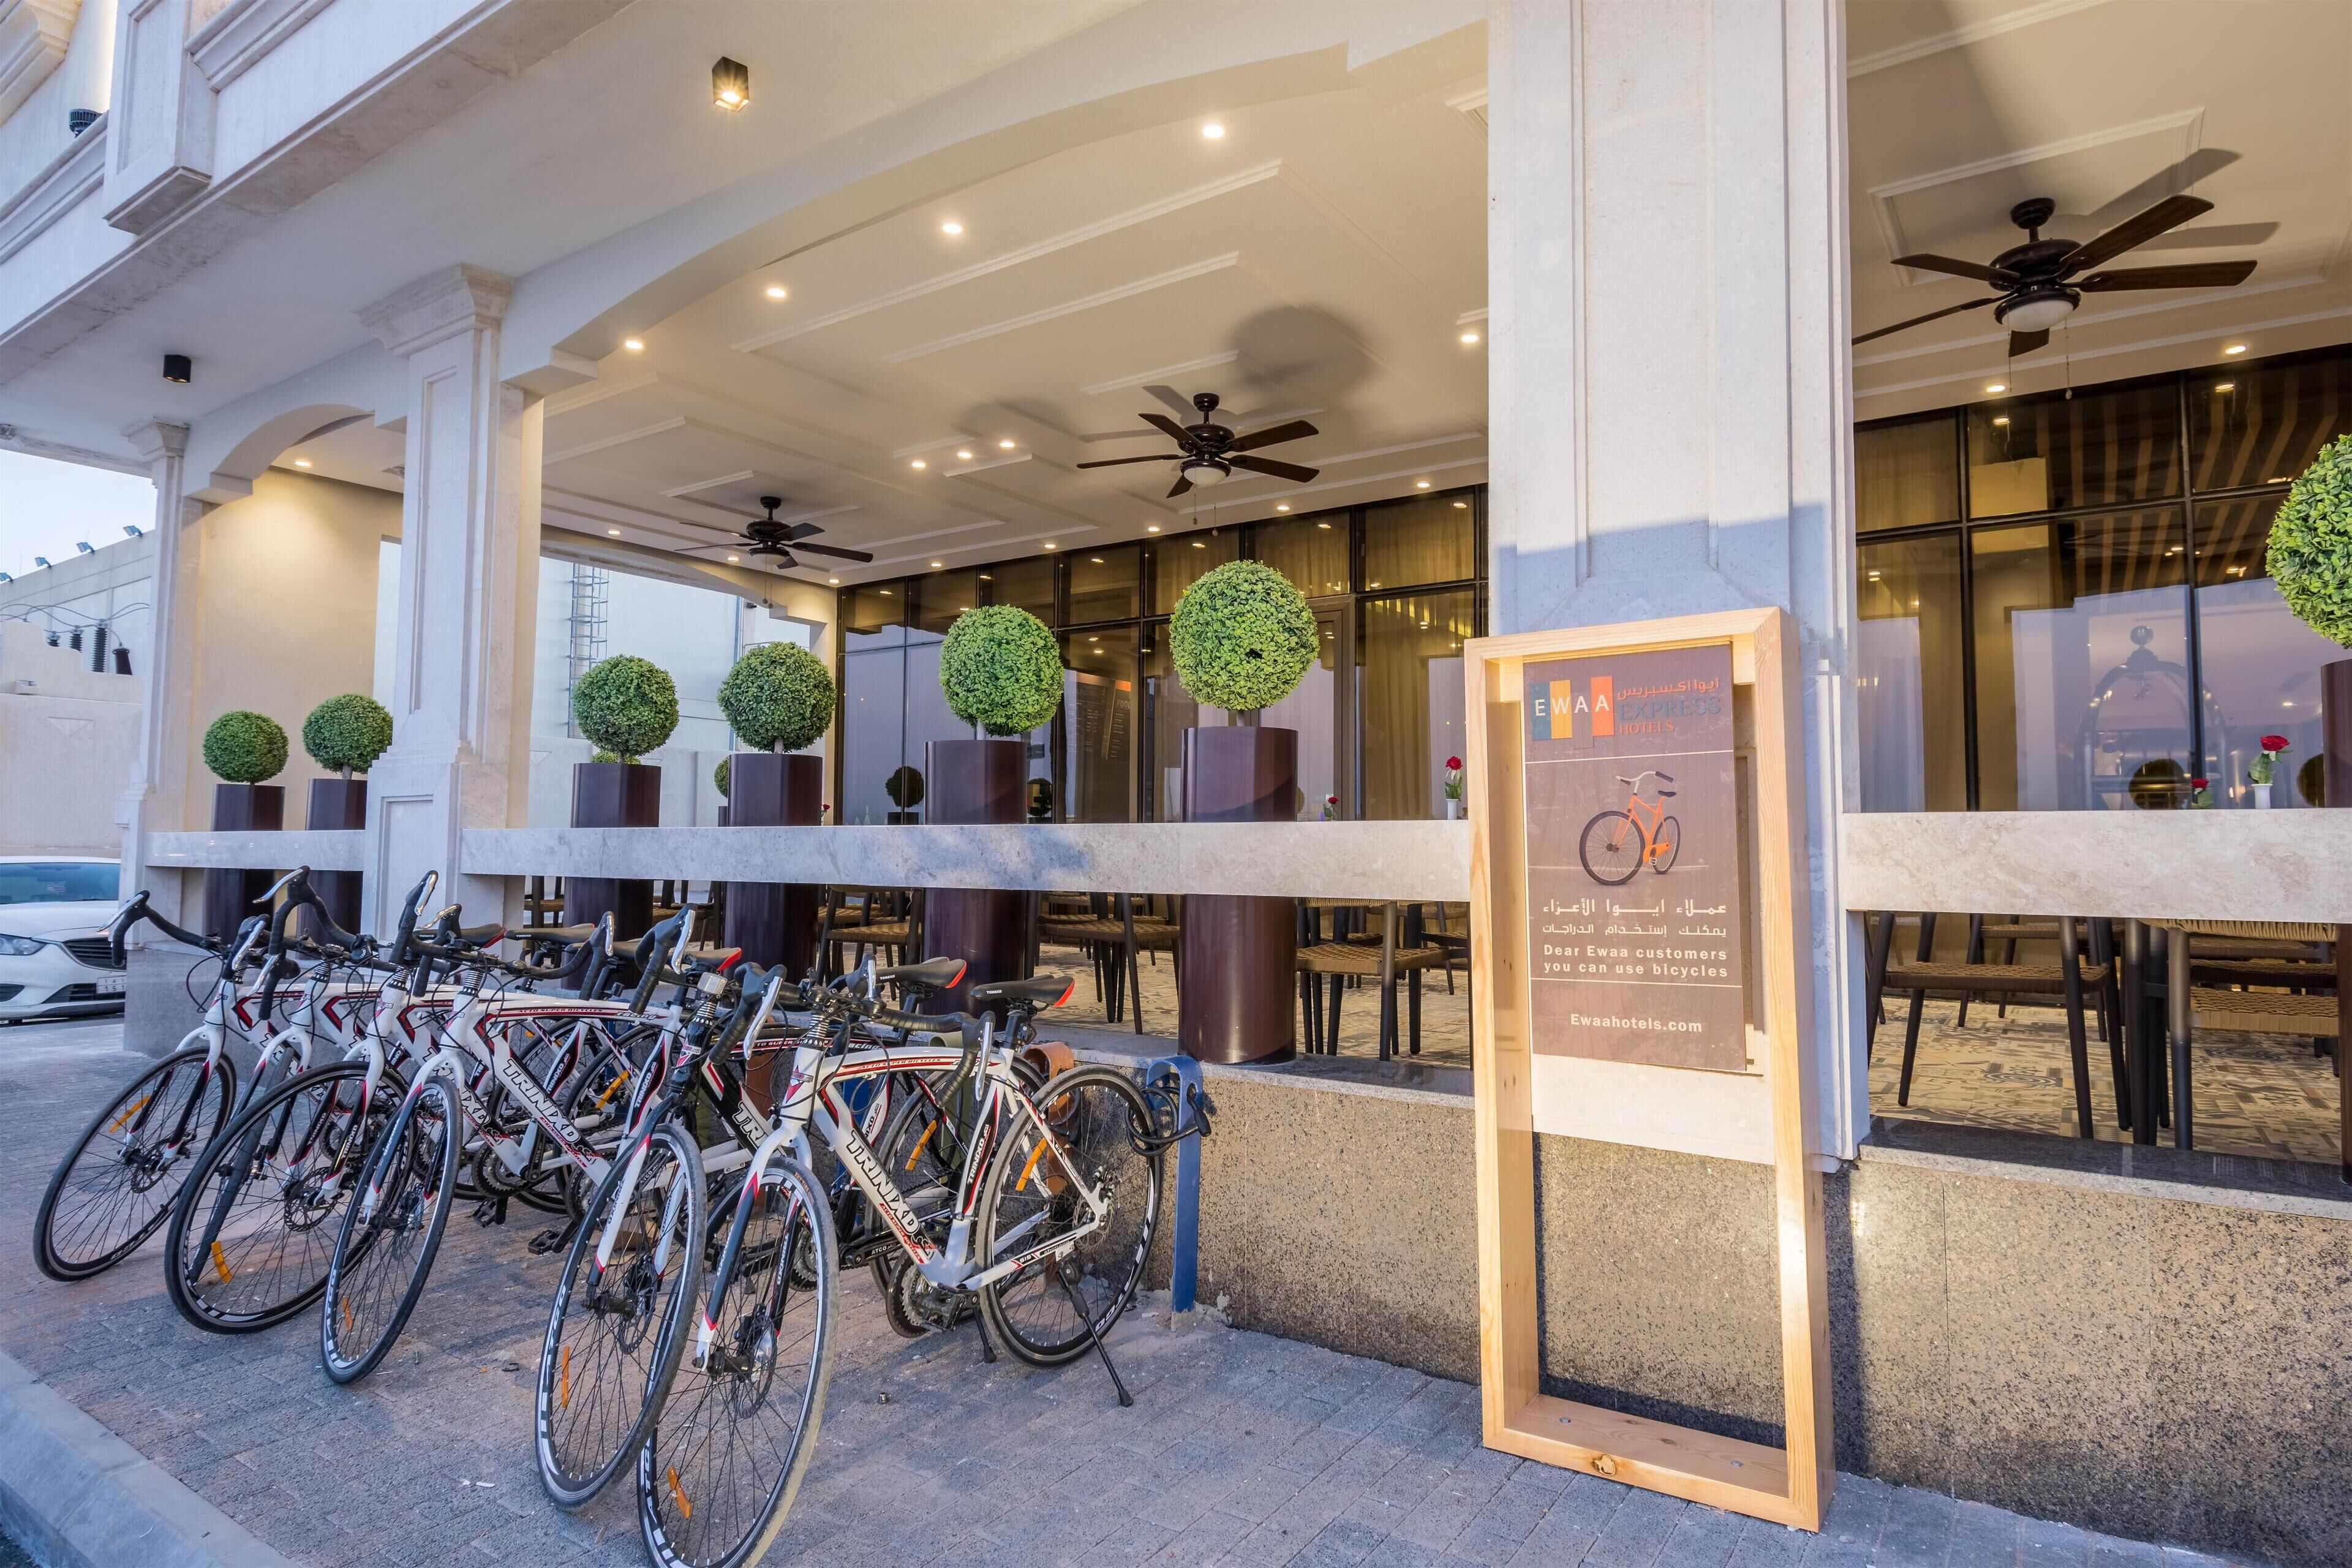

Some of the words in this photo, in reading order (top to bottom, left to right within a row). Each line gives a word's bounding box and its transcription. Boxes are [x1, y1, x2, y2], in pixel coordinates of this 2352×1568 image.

[1616, 679, 1692, 700] اكسبريس
[1694, 676, 1720, 693] ايوا
[1534, 694, 1610, 717] EWAA
[1619, 695, 1721, 722] EXPRESS
[1618, 720, 1675, 736] HOTELS
[1543, 898, 1596, 916] الأعزاء
[1676, 899, 1727, 917] عملاء
[1542, 924, 1594, 935] الدراجات
[1678, 925, 1727, 938] يمكنك
[1544, 944, 1580, 957] Dear
[1586, 945, 1629, 958] Ewaa
[1635, 947, 1727, 960] customers
[1543, 961, 1571, 974] you
[1578, 963, 1607, 973] can
[1616, 964, 1645, 974] use
[1653, 963, 1728, 979] bicycles
[1570, 1013, 1703, 1033] Ewaahotels.com
[872, 1246, 887, 1255] ATCO
